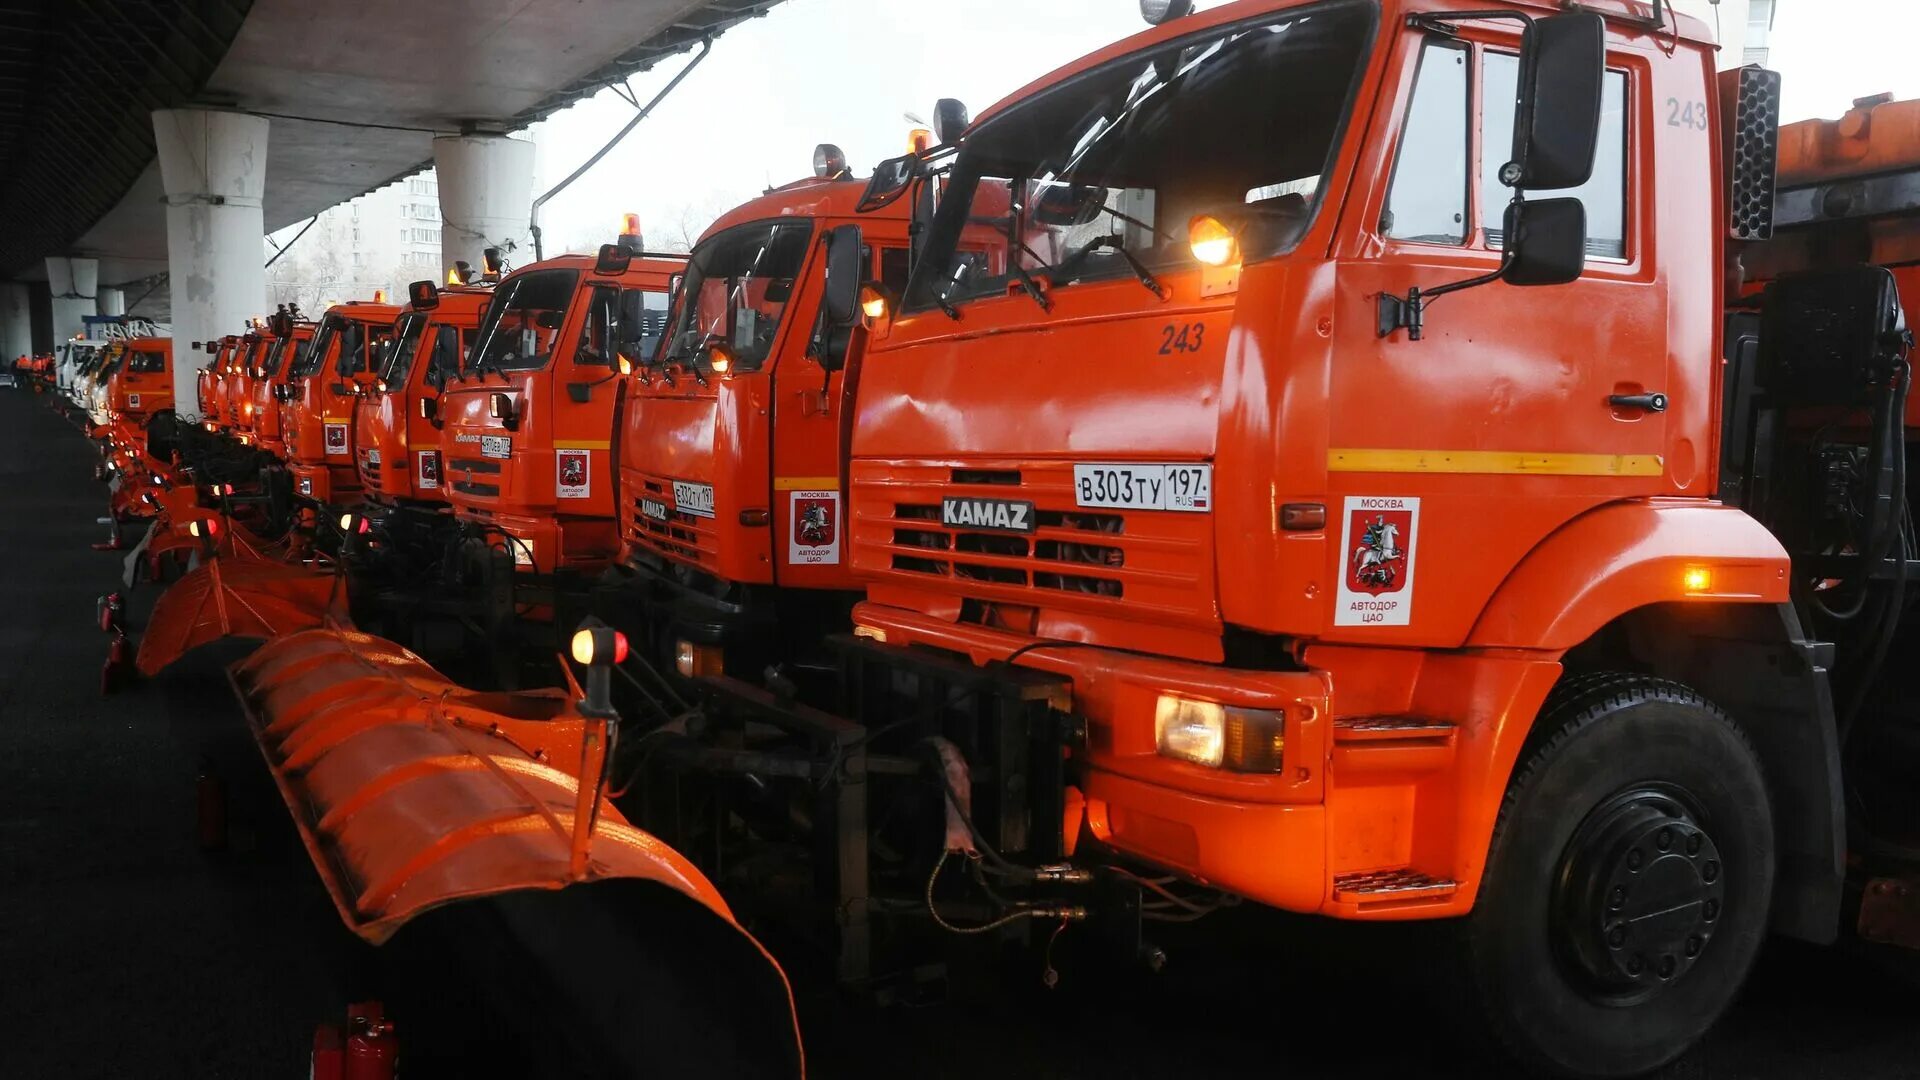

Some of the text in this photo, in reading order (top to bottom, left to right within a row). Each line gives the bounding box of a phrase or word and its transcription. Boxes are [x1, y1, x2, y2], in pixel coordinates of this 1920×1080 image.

[1667, 97, 1706, 131] 243
[1158, 322, 1204, 355] 243
[1082, 469, 1203, 504] В303ТУ 197
[642, 499, 666, 521] KAMAZ
[1175, 496, 1193, 507] RUS
[1361, 499, 1404, 509] МОСКВА
[943, 499, 1028, 530] KAMAZ
[1350, 601, 1398, 611] АВТОДОР
[1362, 613, 1384, 623] ЦАО
